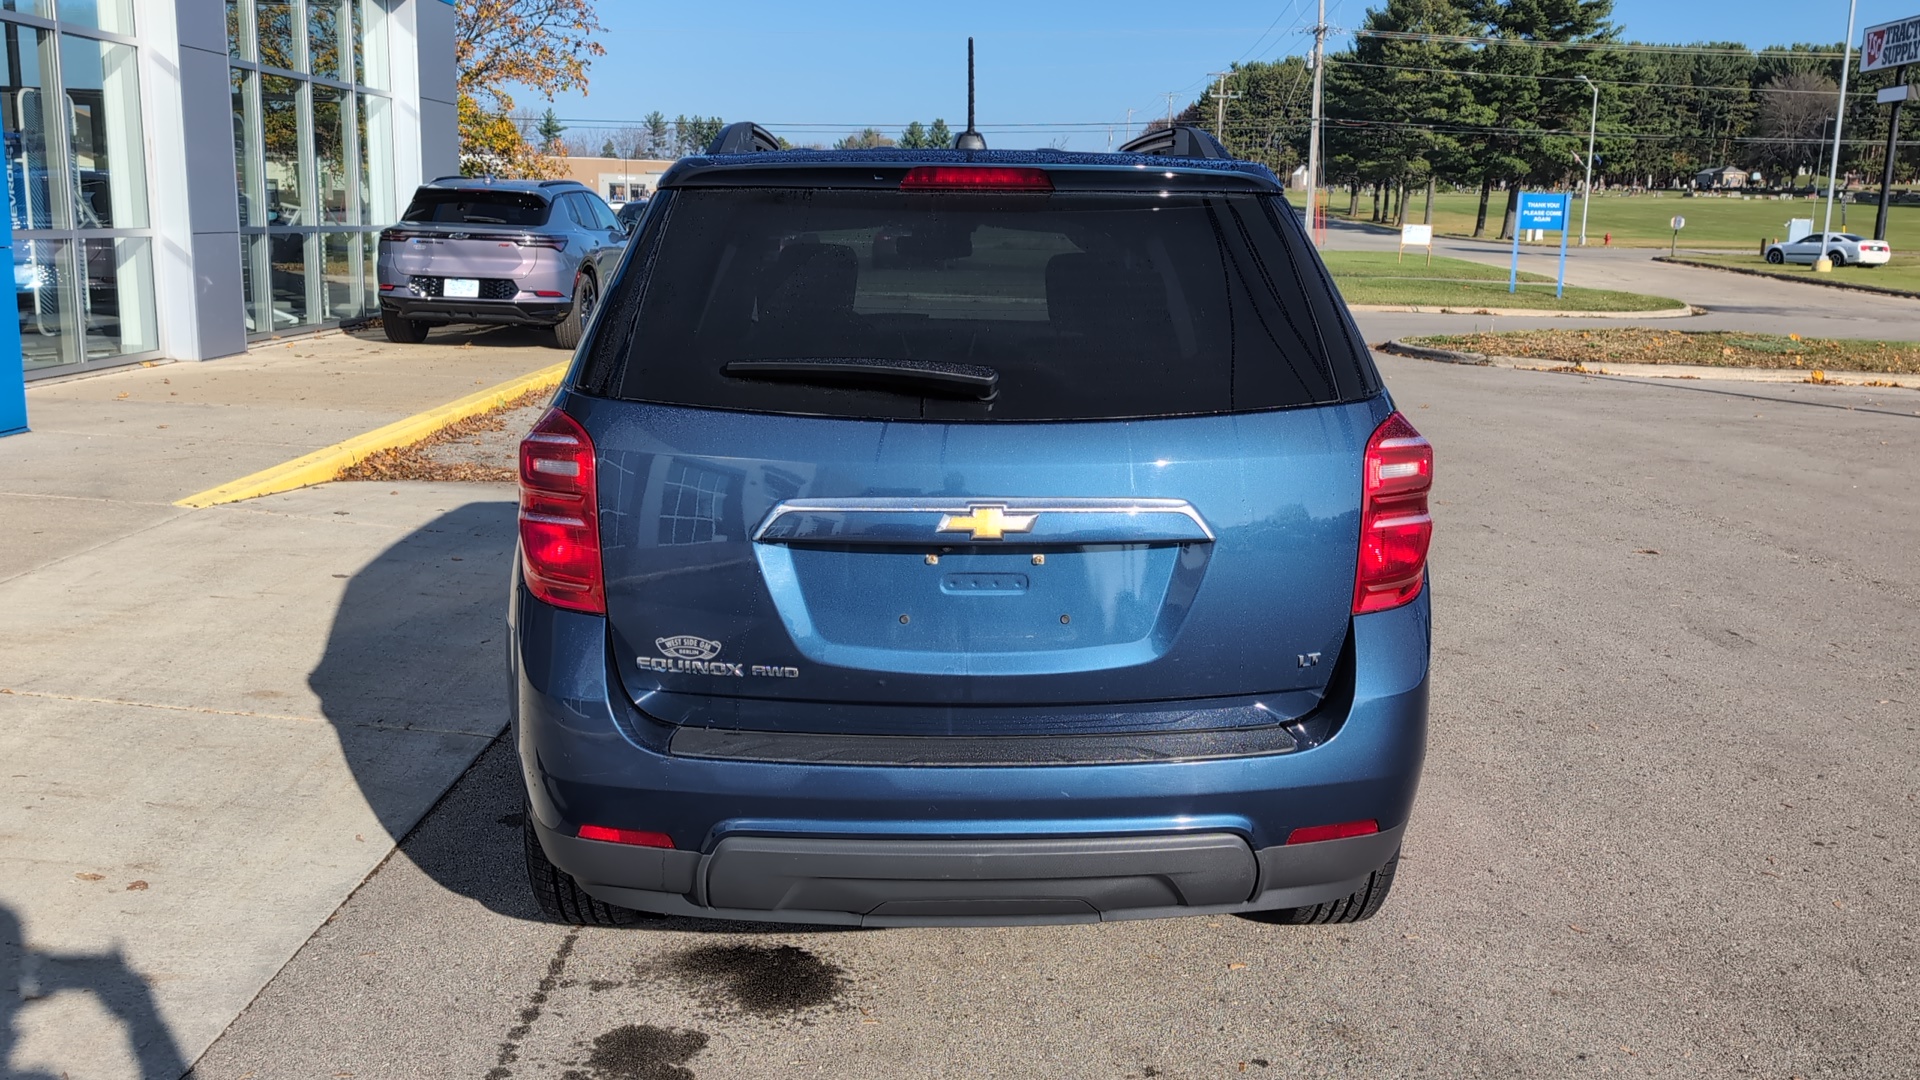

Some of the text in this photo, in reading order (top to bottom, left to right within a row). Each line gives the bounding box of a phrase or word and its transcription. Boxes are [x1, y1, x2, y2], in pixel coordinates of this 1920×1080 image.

[1886, 20, 1920, 45] TRACT
[1868, 33, 1881, 58] TSC
[1882, 40, 1920, 65] SUPPLY
[665, 638, 712, 651] WEST SIDE GM
[636, 656, 799, 677] EQUINOX AWD
[1297, 652, 1321, 668] LT
